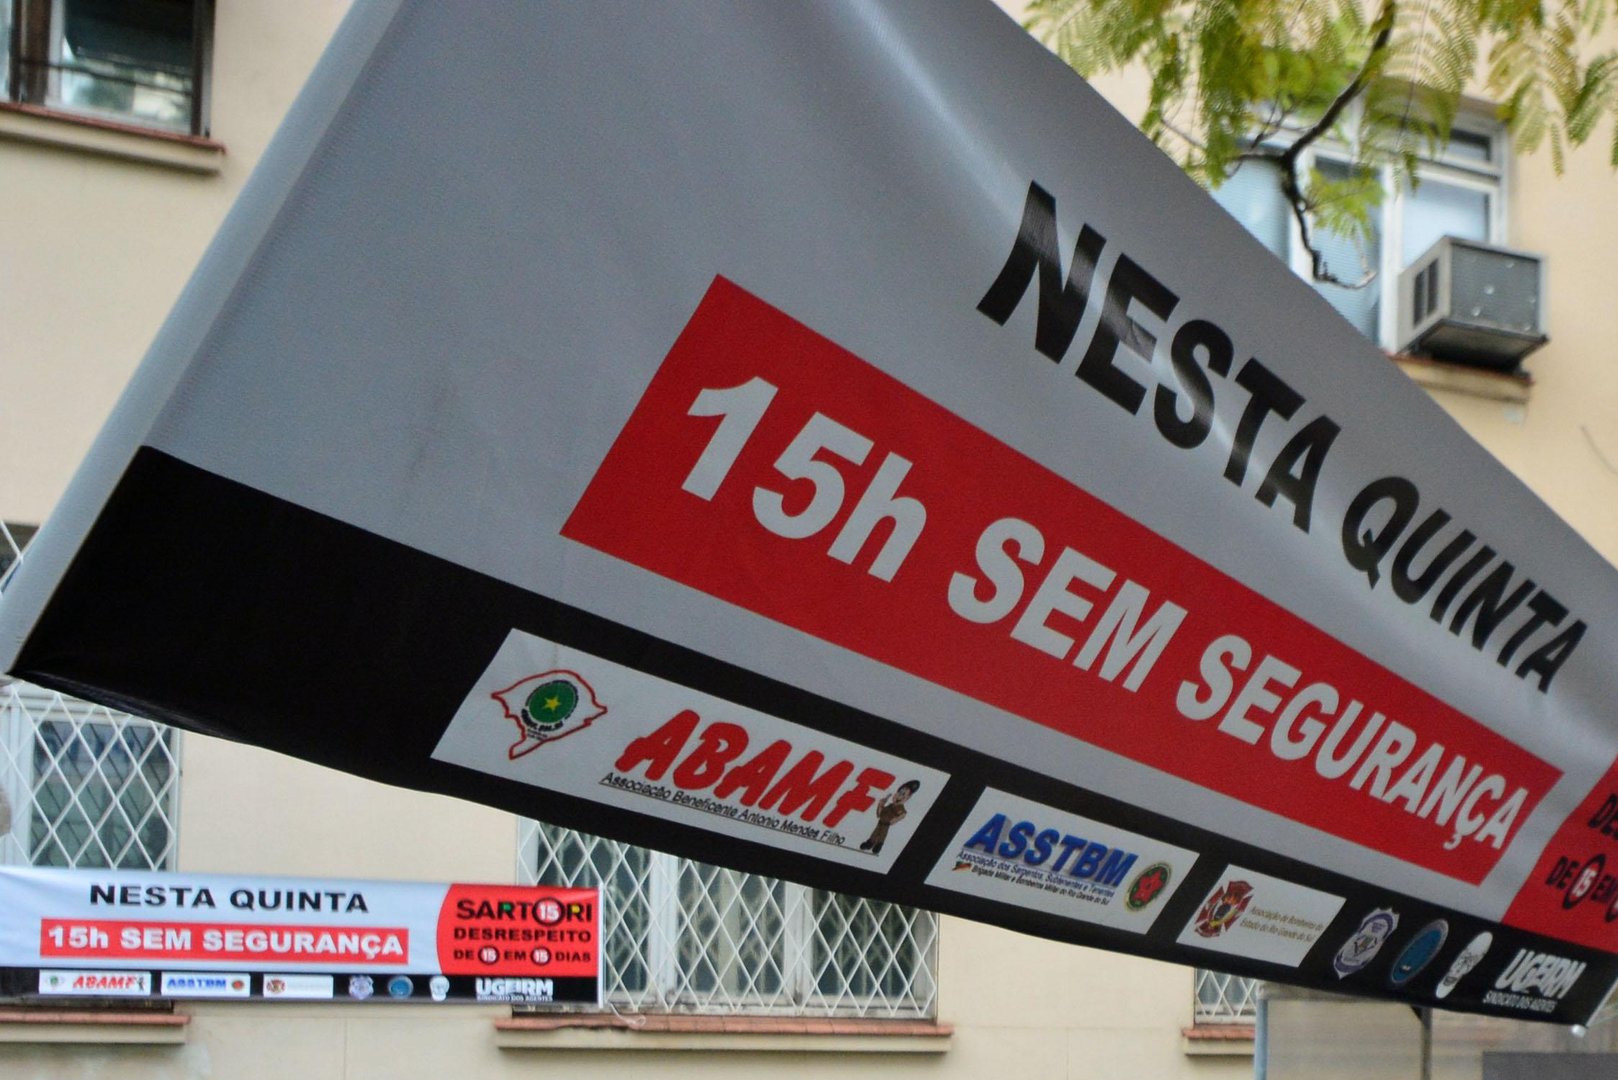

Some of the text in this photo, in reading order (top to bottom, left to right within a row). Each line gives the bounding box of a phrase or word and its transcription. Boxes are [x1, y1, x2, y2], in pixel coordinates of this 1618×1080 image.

[976, 180, 1588, 694] NESTA QUINTA
[682, 376, 1529, 850] 15h SEM SEGURANÇA
[615, 709, 896, 829] ABAMF
[601, 772, 846, 845] Associação Beneficente Antonio Mendes Filho
[963, 813, 1139, 888] ASSTBM
[1546, 856, 1581, 890] DE
[89, 884, 369, 914] NESTA QUINTA
[49, 925, 405, 961] 15h SEM SEGURANÇA
[454, 927, 592, 943] DESRESPEITO
[454, 949, 475, 960] DE
[504, 950, 527, 961] EM
[555, 951, 592, 962] DIAS
[475, 977, 554, 997] UGEIRM
